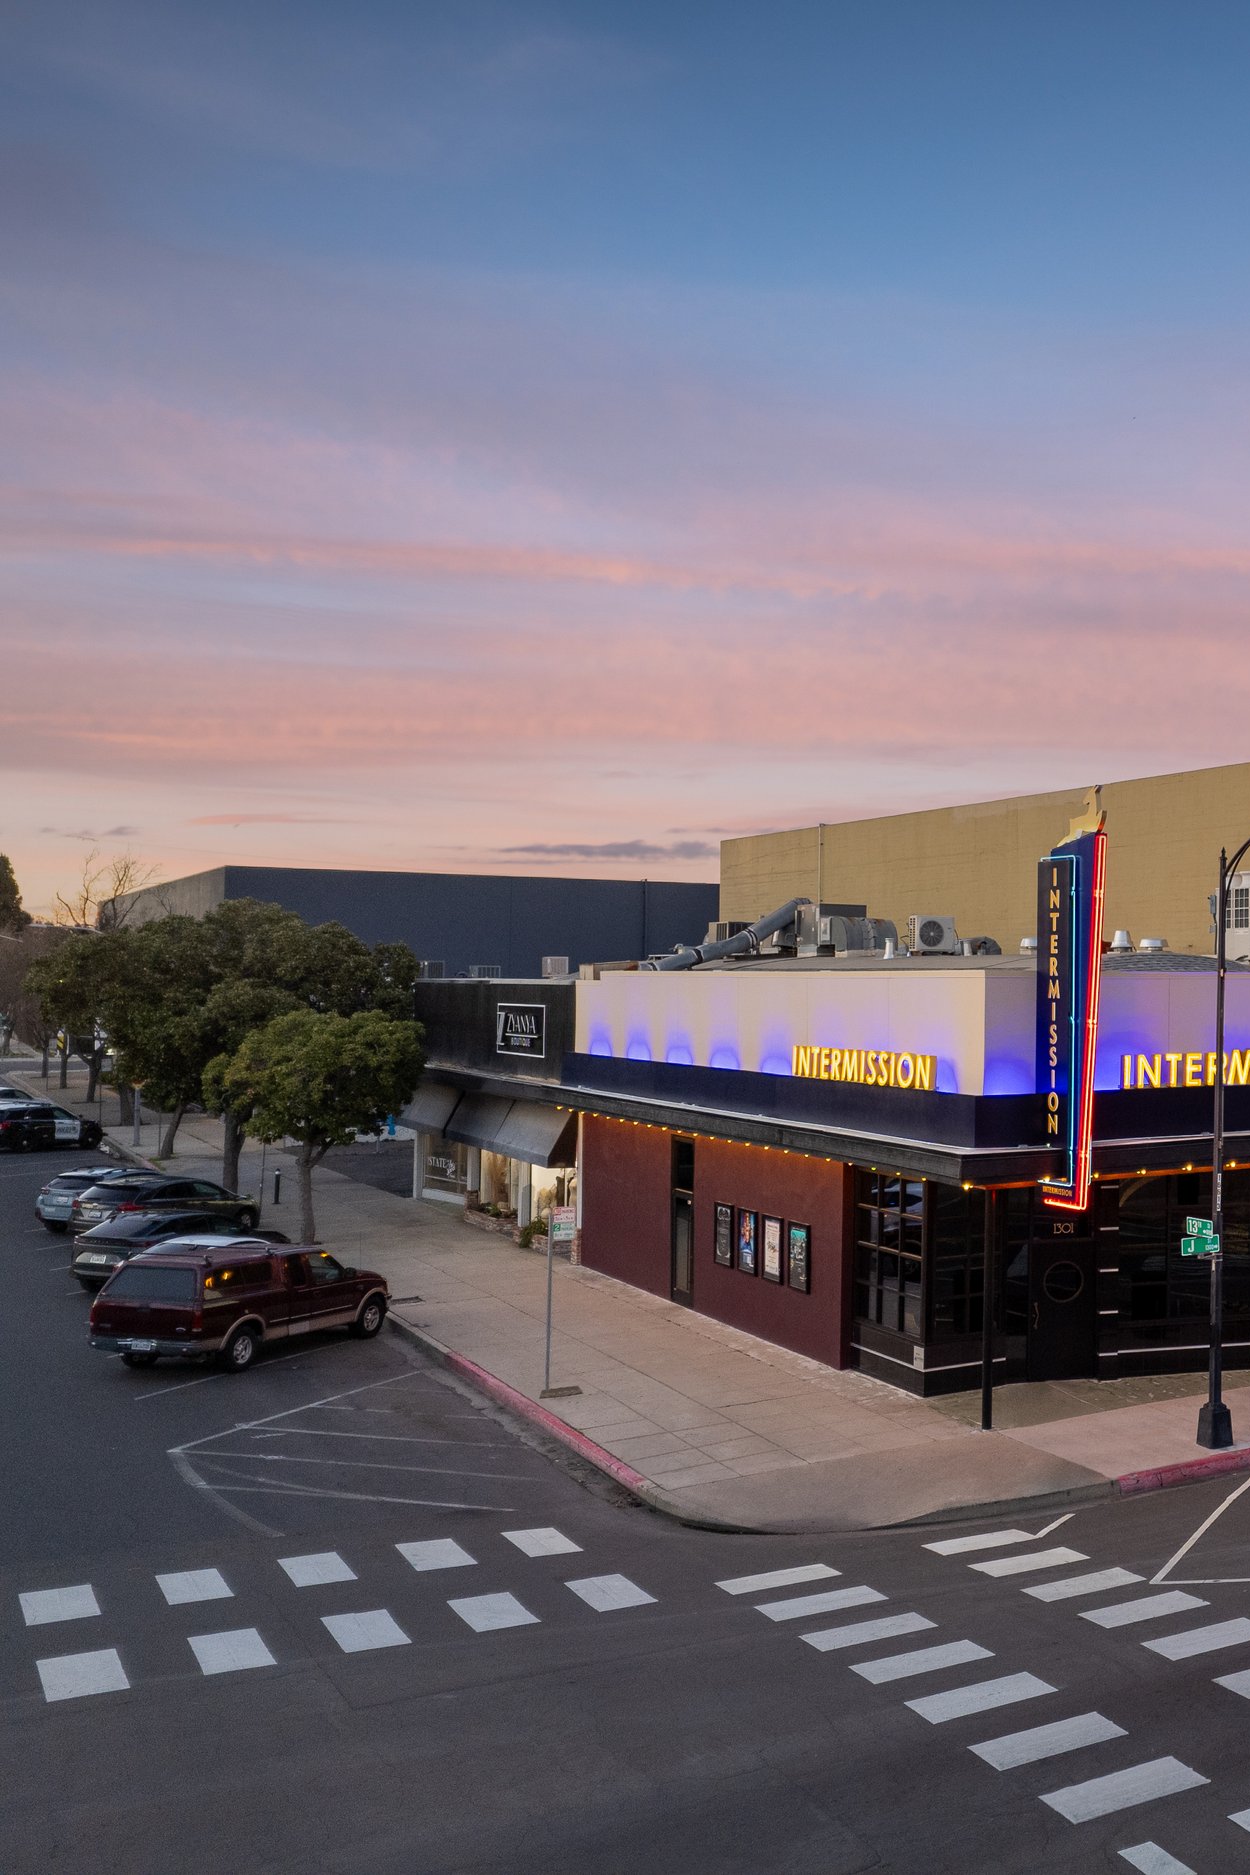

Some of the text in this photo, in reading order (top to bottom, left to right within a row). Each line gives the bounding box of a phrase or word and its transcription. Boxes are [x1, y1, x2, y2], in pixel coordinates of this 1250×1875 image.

[1047, 867, 1061, 1136] INTERMISSION
[792, 1045, 935, 1091] INTERMISSION
[1053, 1223, 1074, 1234] 1301
[1187, 1239, 1195, 1252] J
